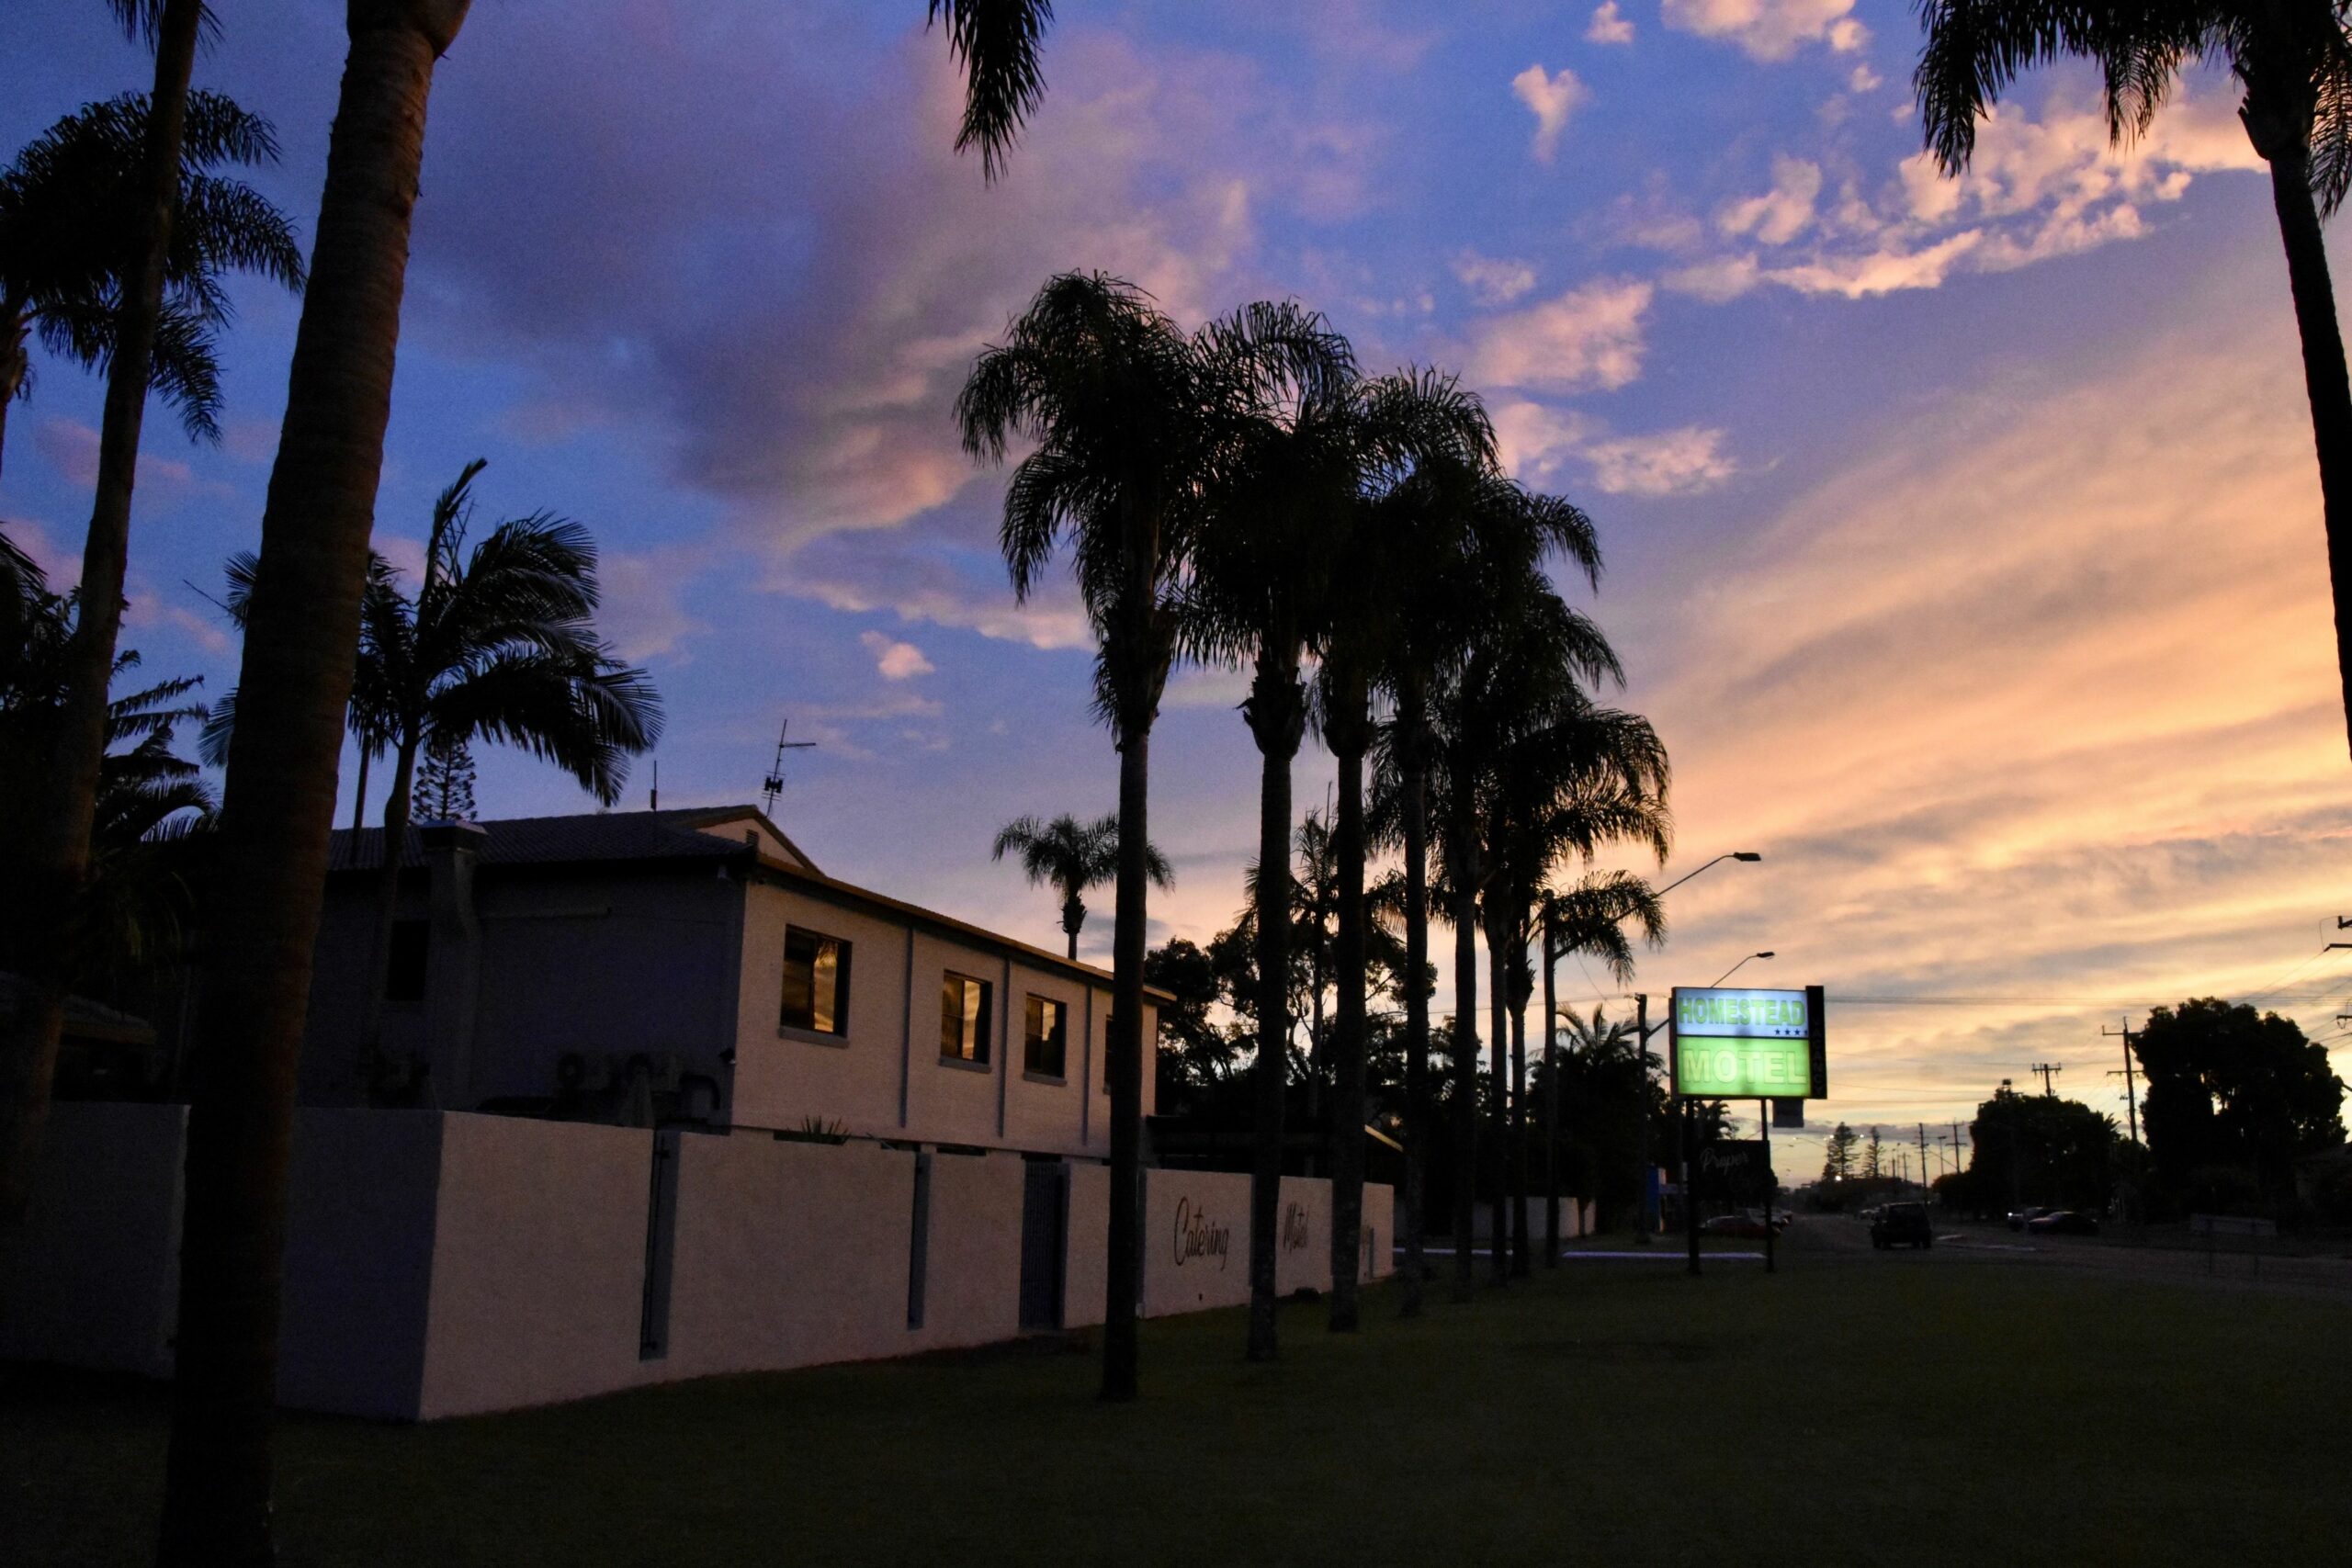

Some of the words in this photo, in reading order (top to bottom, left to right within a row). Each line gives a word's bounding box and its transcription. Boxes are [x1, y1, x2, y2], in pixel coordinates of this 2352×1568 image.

[1678, 998, 1806, 1027] HOMESTEAD
[1682, 1049, 1807, 1085] MOTEL
[1812, 1017, 1824, 1096] VACANCY
[1173, 1196, 1230, 1271] Catering
